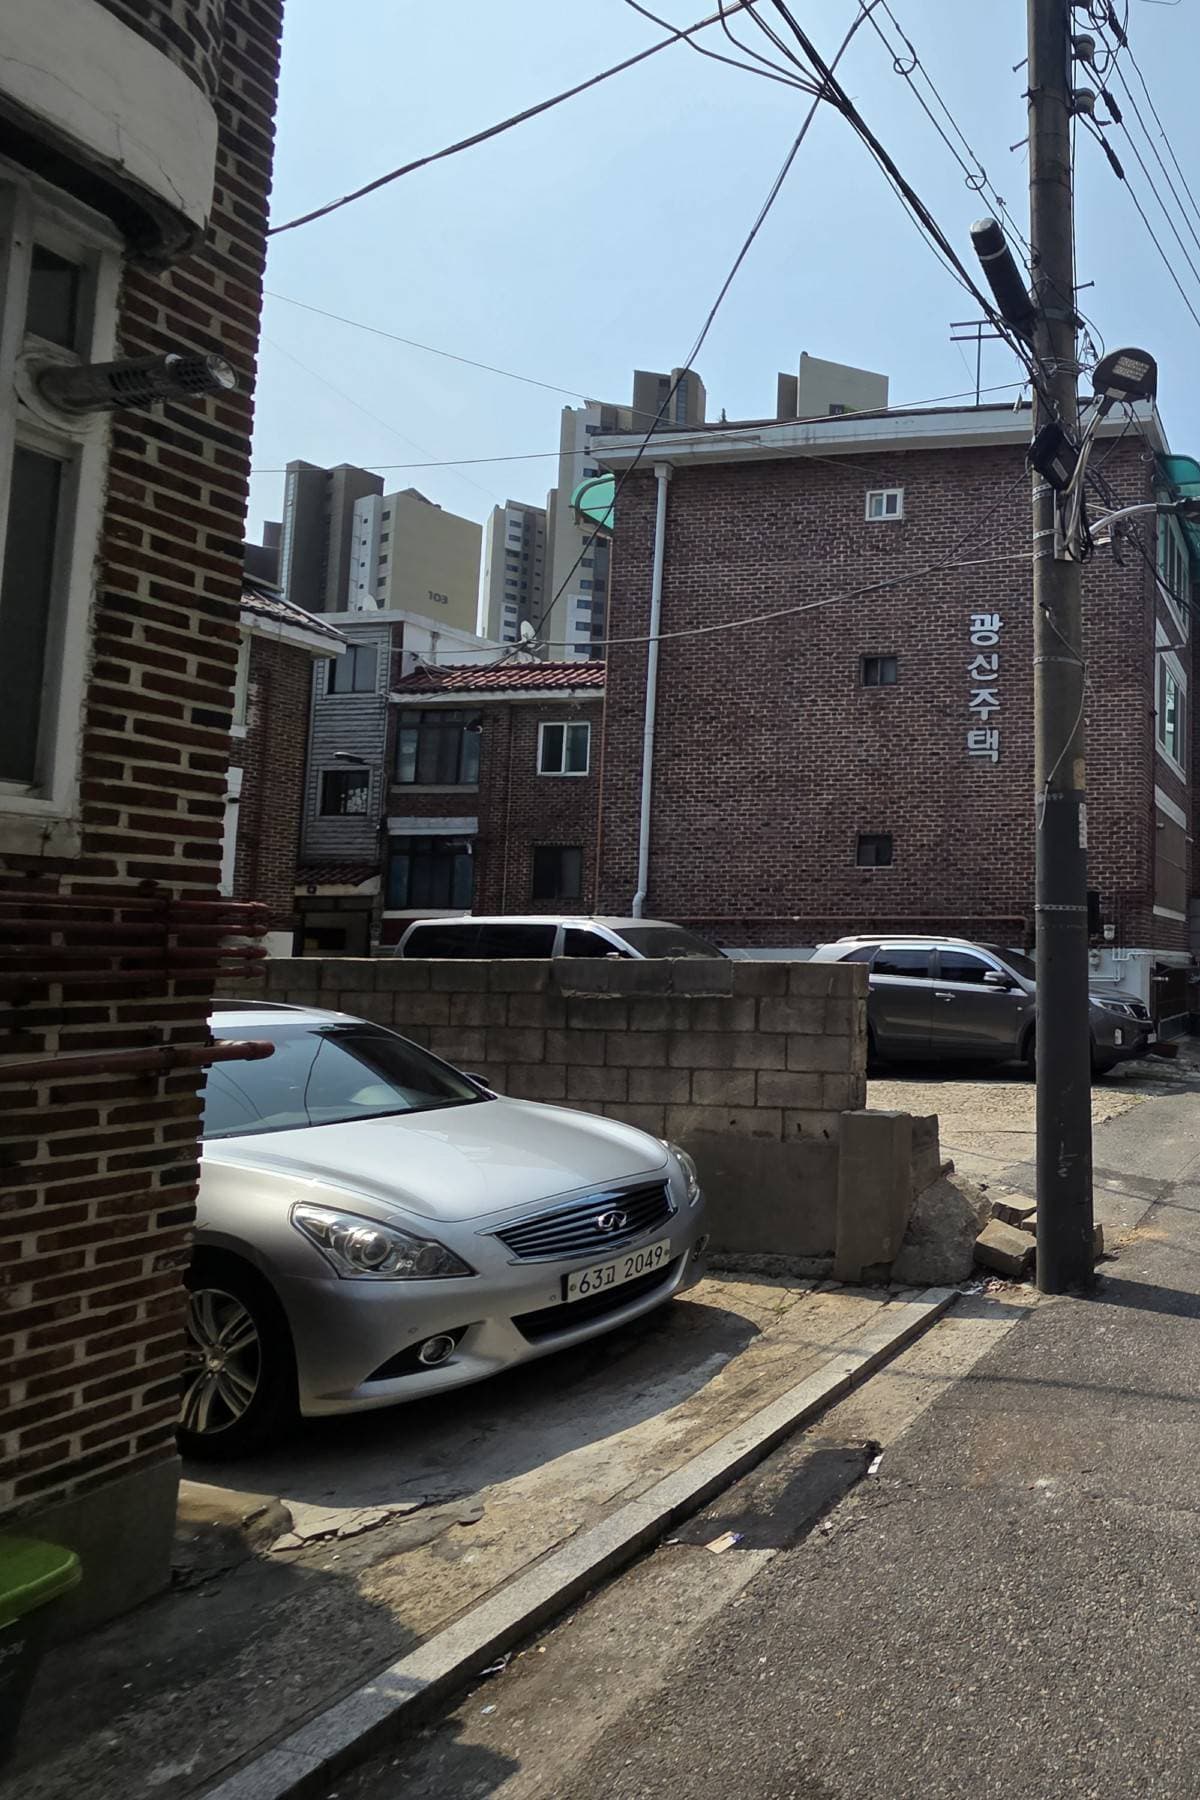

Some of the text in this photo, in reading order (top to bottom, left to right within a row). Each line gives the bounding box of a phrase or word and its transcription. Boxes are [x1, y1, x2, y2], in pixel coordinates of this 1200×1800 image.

[427, 590, 449, 605] 103
[967, 613, 1004, 764] 광신주택
[579, 1245, 663, 1294] 63고 2049
